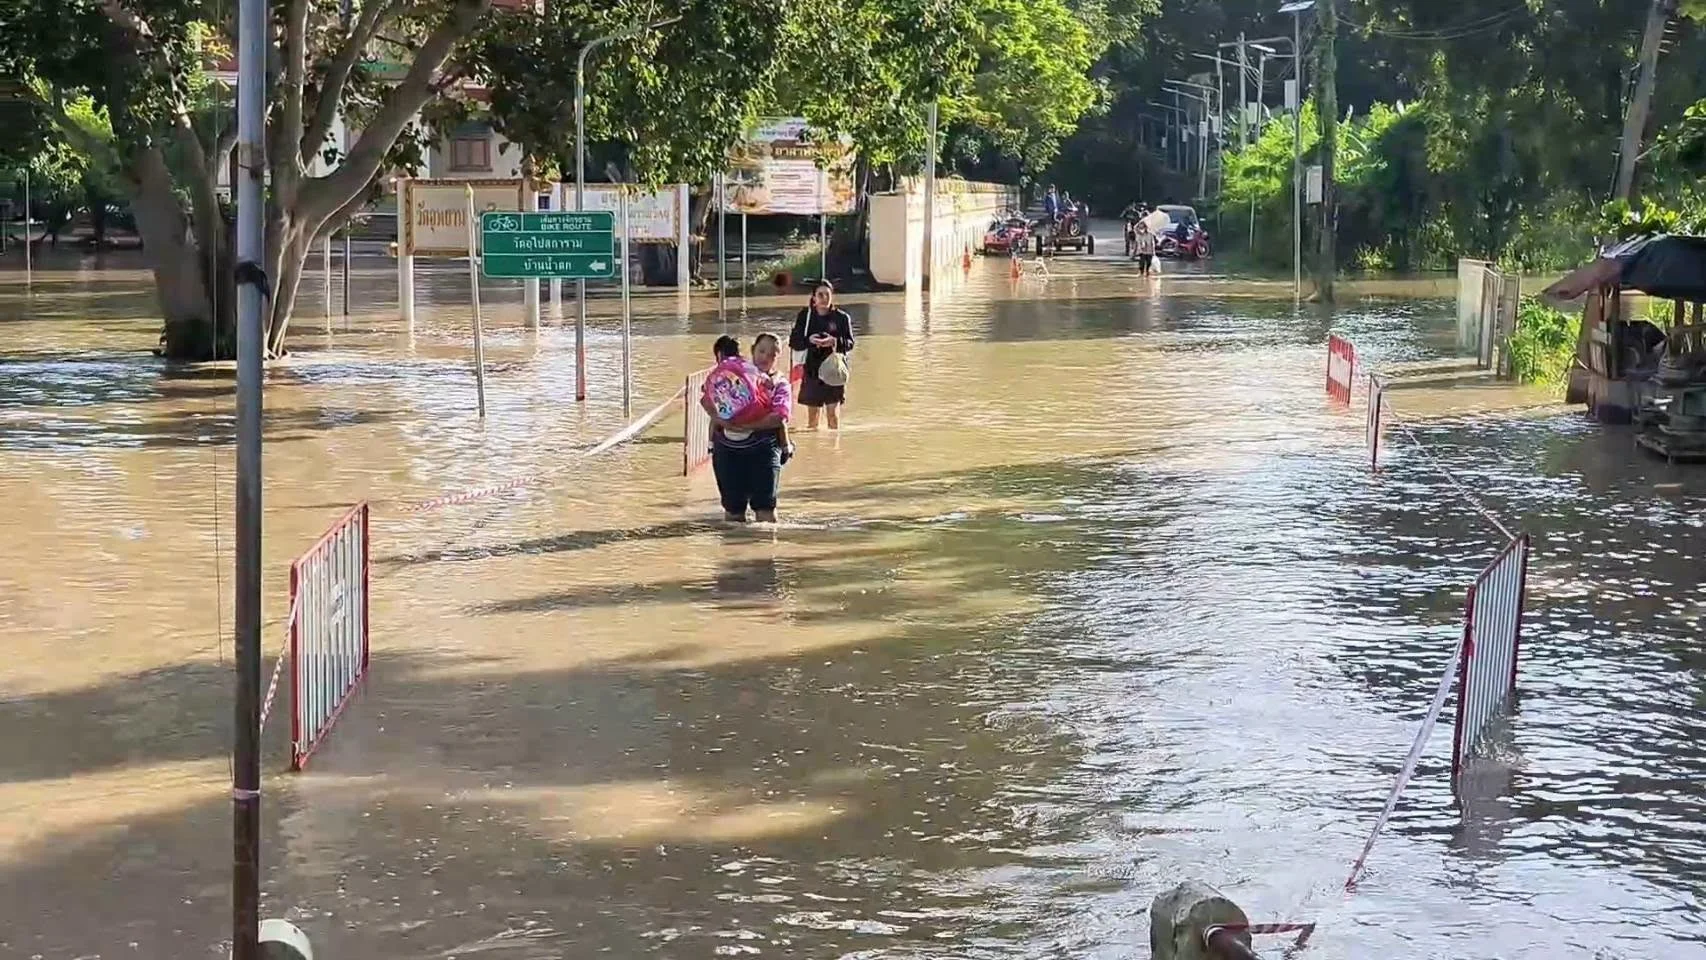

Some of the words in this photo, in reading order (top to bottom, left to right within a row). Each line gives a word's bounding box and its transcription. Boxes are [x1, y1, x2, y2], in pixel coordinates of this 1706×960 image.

[540, 214, 592, 224] เส้นทางจักรยาน
[540, 223, 561, 231] BIKE
[562, 223, 592, 231] ROUTE
[523, 256, 572, 271] บ้านน้ำตก
